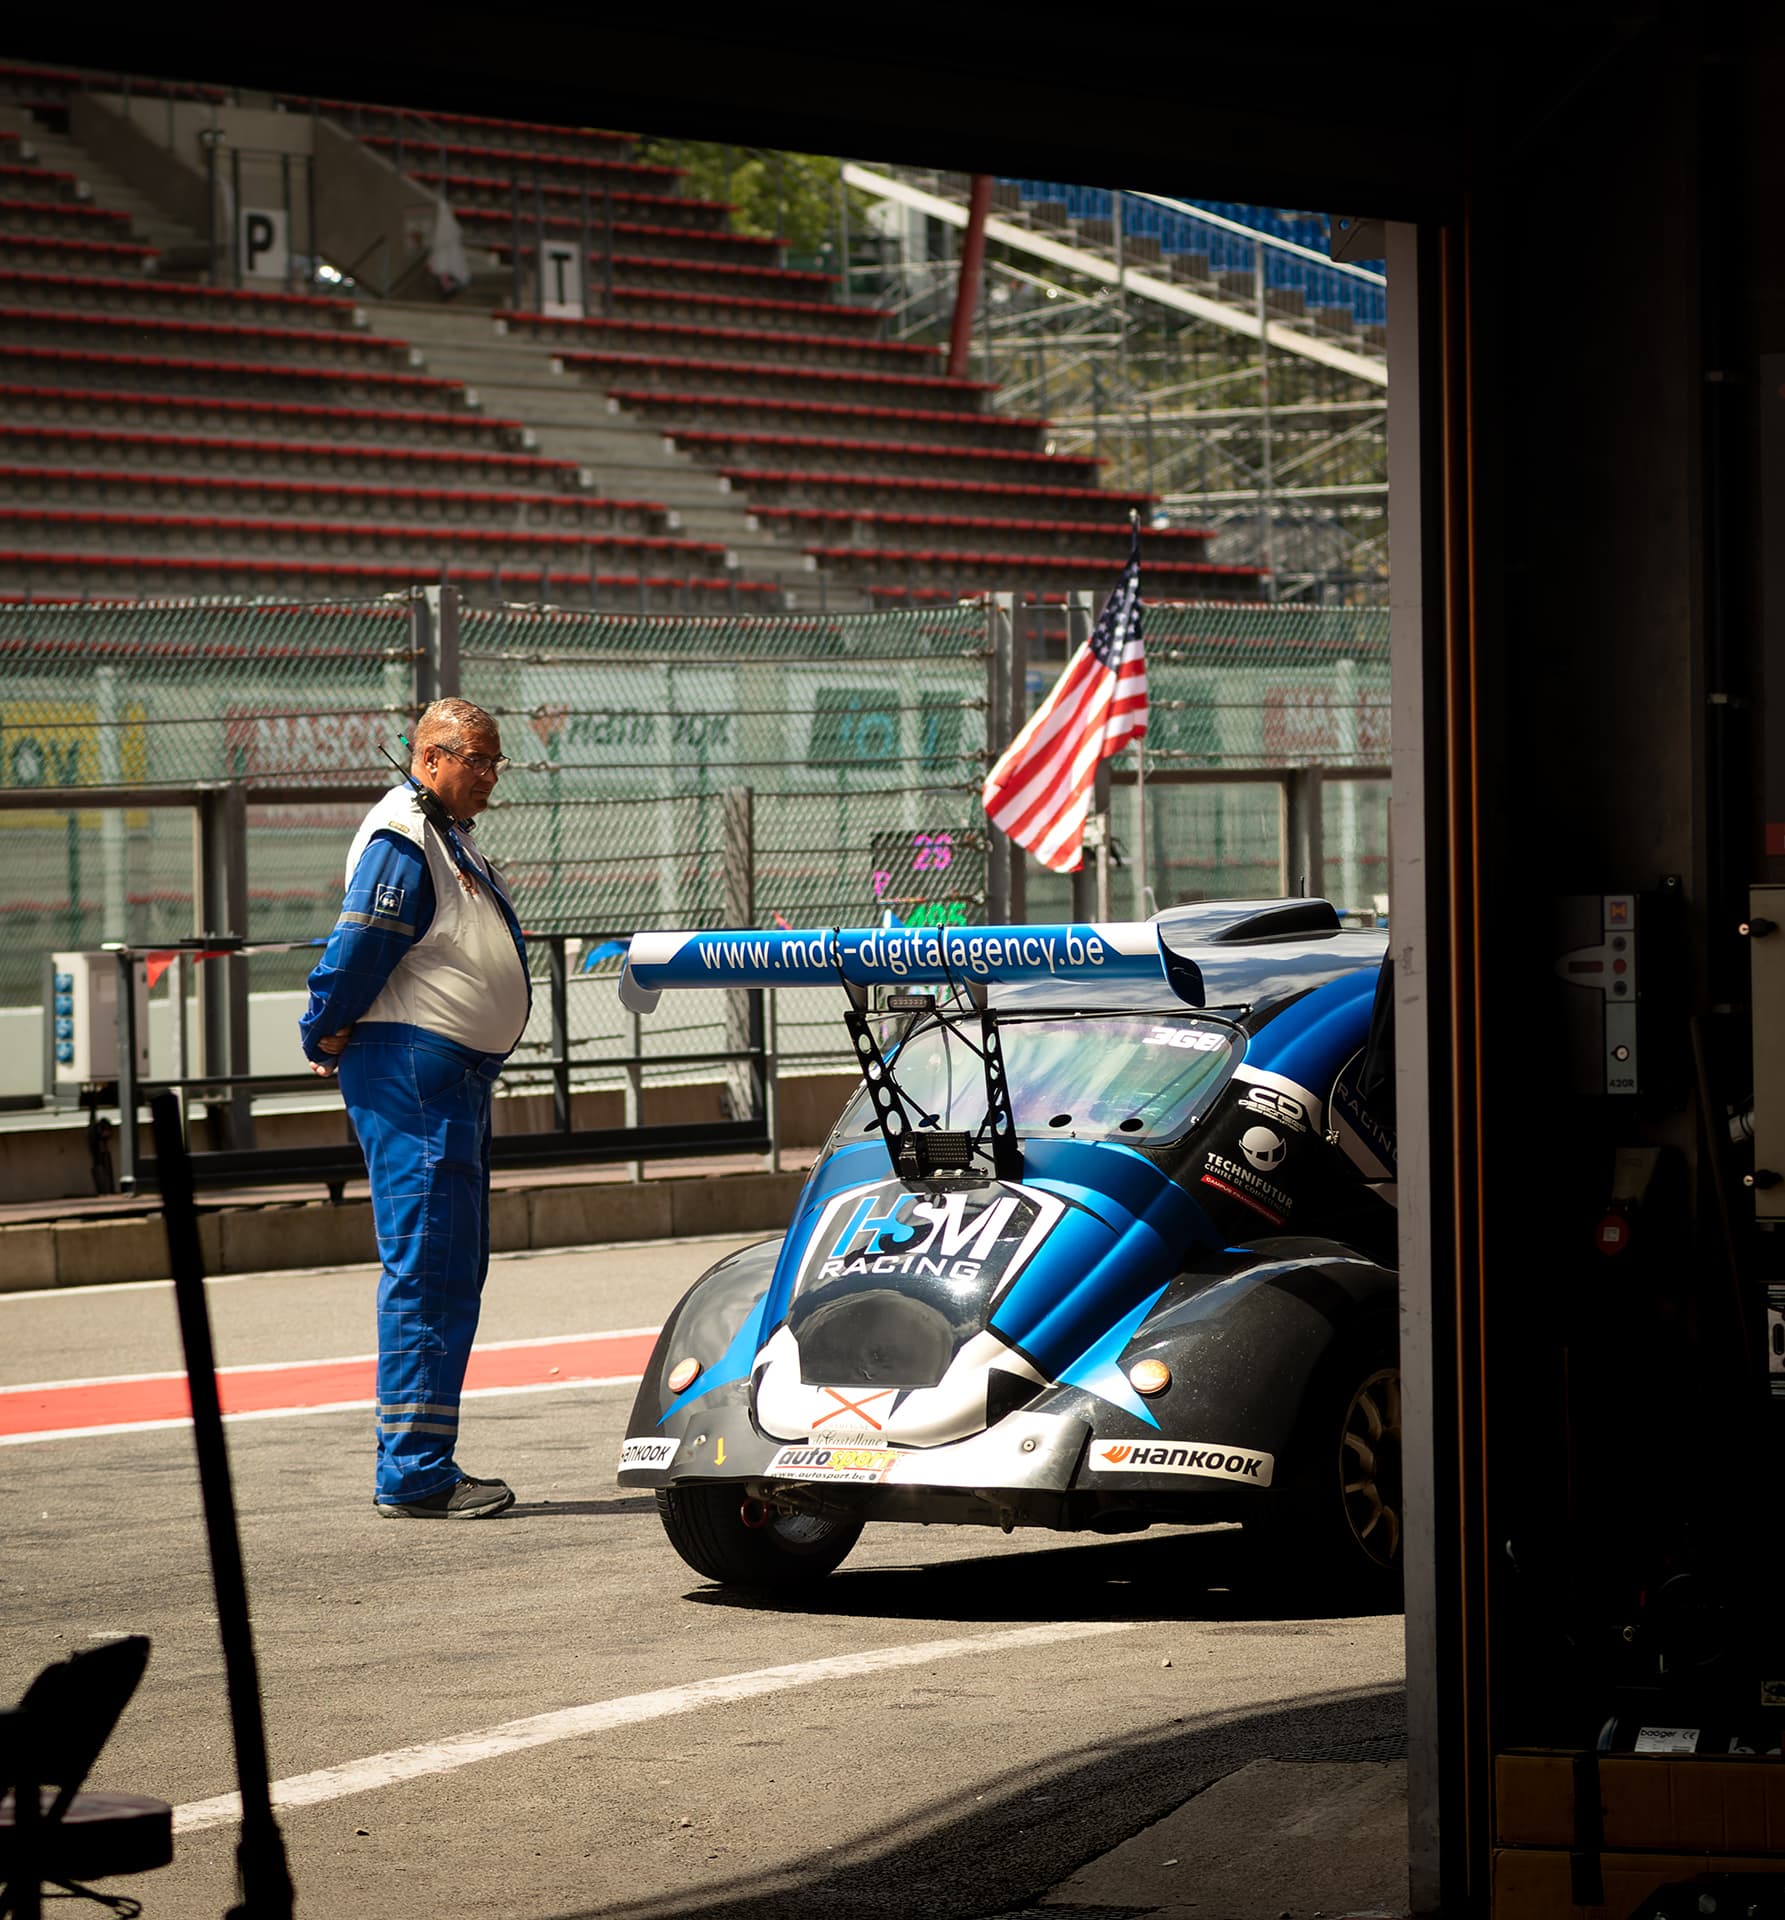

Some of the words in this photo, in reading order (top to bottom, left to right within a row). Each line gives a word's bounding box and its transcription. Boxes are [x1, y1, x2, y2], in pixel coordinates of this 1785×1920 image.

[247, 214, 275, 273] P
[551, 249, 573, 306] T
[698, 926, 1105, 975] www.mds-digitalagency.be
[1207, 1152, 1294, 1209] TECHNIFUTUR
[828, 1193, 1020, 1261] HSM
[818, 1255, 982, 1281] RACING
[778, 1447, 897, 1472] autosport
